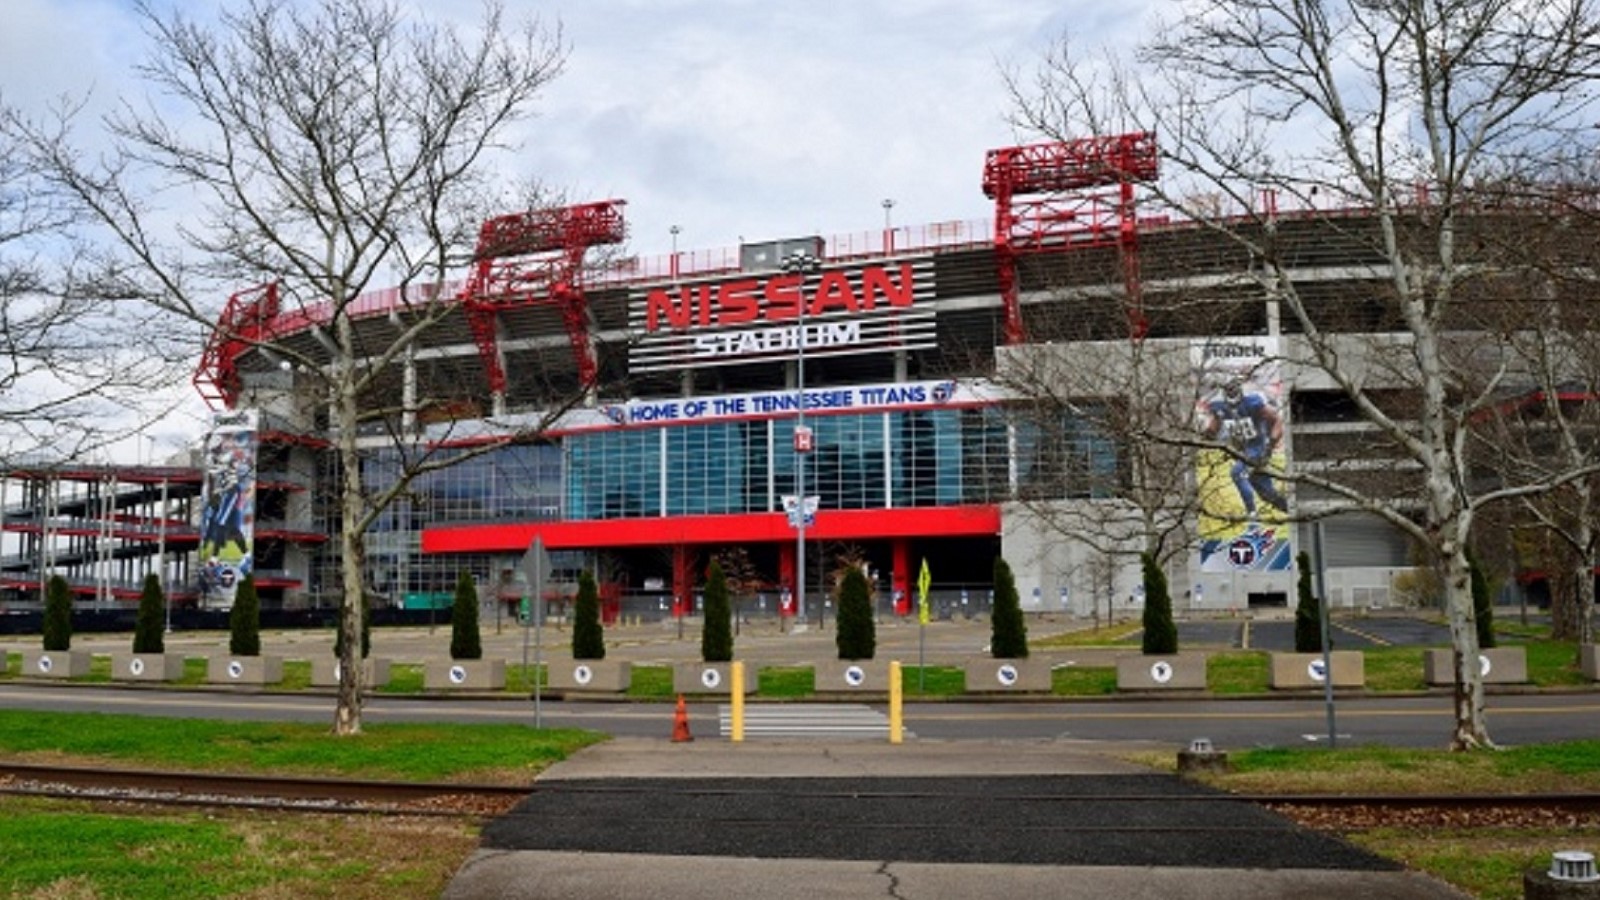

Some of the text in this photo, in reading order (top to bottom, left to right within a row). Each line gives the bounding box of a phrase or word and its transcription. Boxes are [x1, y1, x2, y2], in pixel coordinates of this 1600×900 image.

[646, 264, 913, 332] NISSAN
[694, 321, 861, 357] STADIUM
[630, 386, 926, 422] HOME OF THE TENNESSEE TITANS
